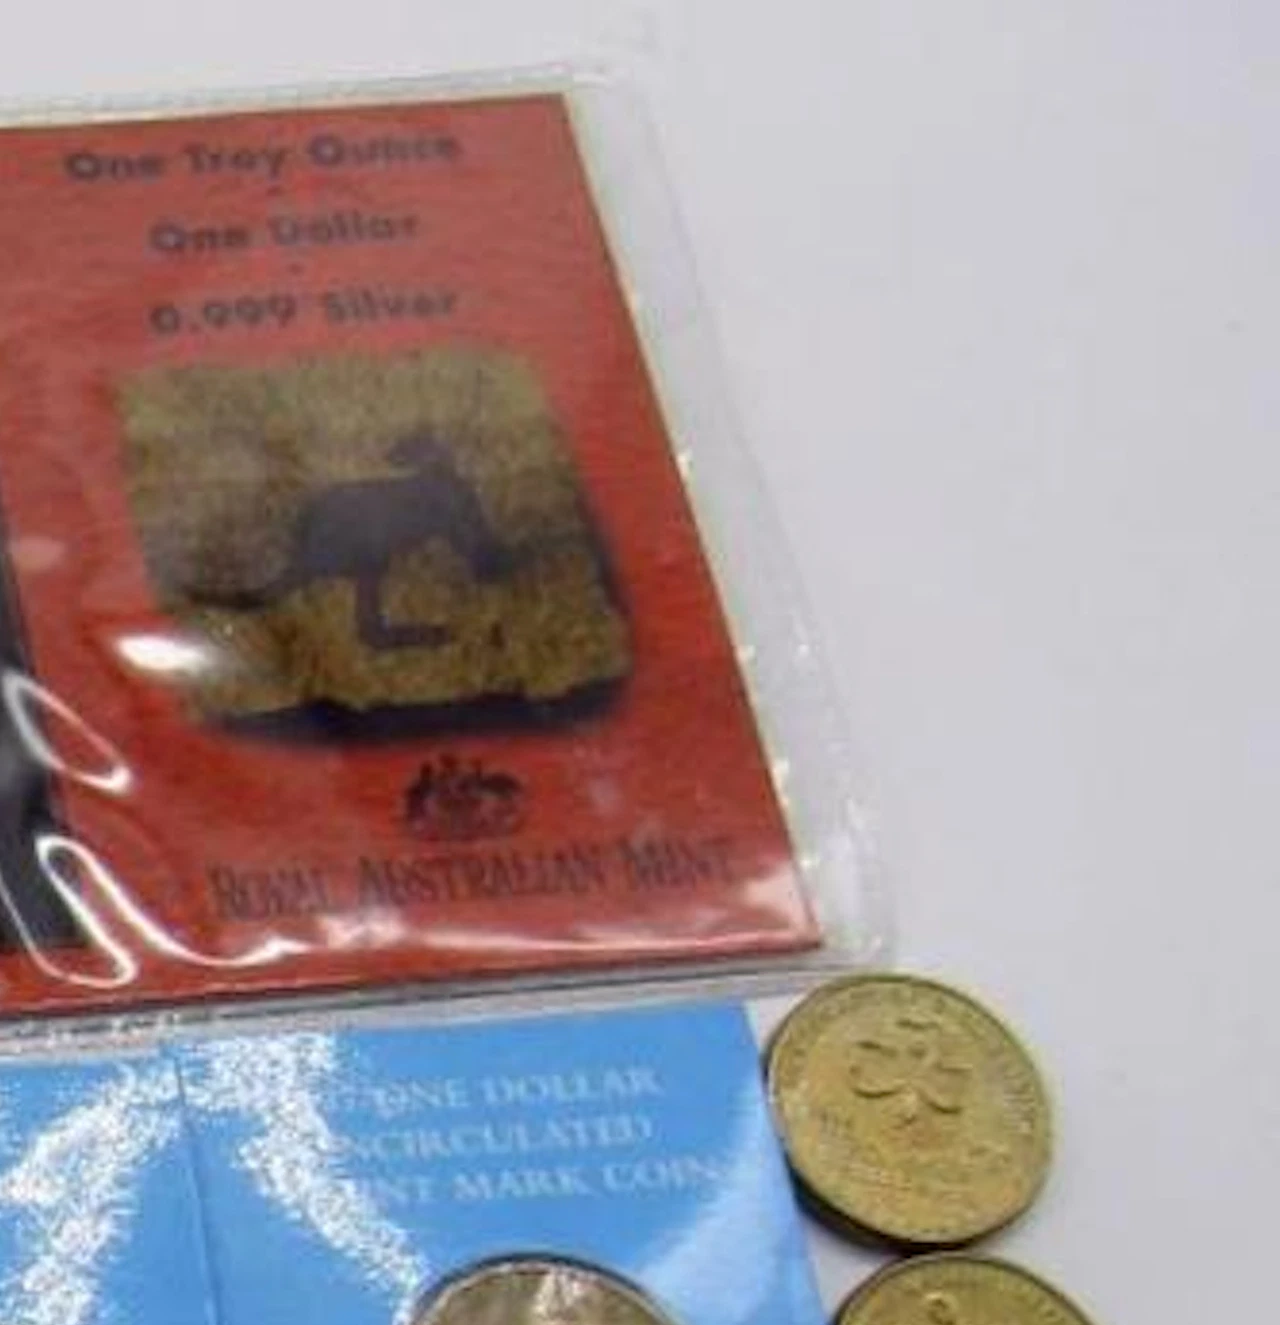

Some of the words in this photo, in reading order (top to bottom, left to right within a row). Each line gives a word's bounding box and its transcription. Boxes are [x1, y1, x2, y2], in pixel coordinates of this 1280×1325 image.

[62, 148, 164, 182] One
[184, 140, 290, 179] Troy
[307, 133, 461, 168] Ounce
[150, 221, 250, 255] One
[267, 210, 419, 247] Dollar
[150, 301, 297, 337] 0.999
[324, 288, 457, 324] Silver
[481, 1064, 663, 1104] DOLLAR
[338, 1112, 653, 1161] NCIRCULATED
[453, 1163, 594, 1201] MARK
